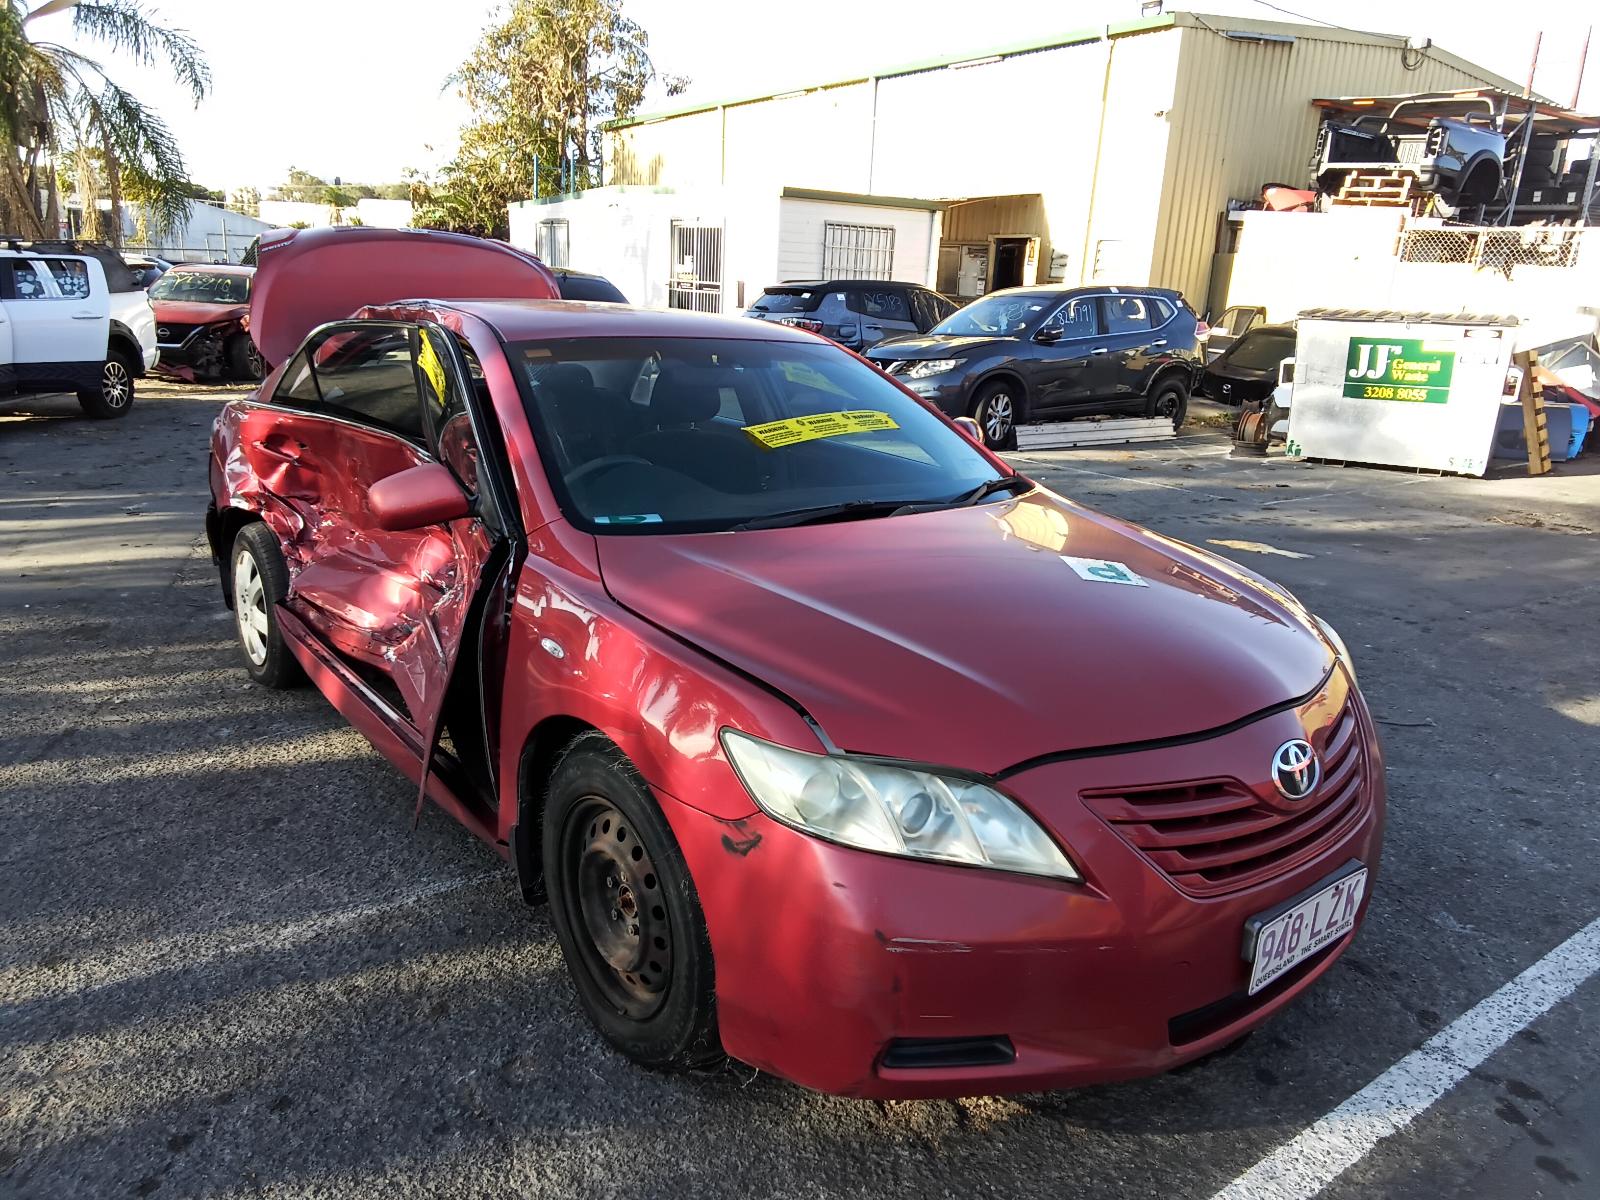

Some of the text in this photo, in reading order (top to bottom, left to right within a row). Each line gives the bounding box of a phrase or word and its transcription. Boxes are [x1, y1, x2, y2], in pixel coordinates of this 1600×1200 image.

[1391, 358, 1441, 372] General
[1391, 369, 1429, 382] Waste
[1363, 386, 1428, 401] 3208 8055
[1254, 919, 1351, 987] QUEENSLAND THE SMART STATE
